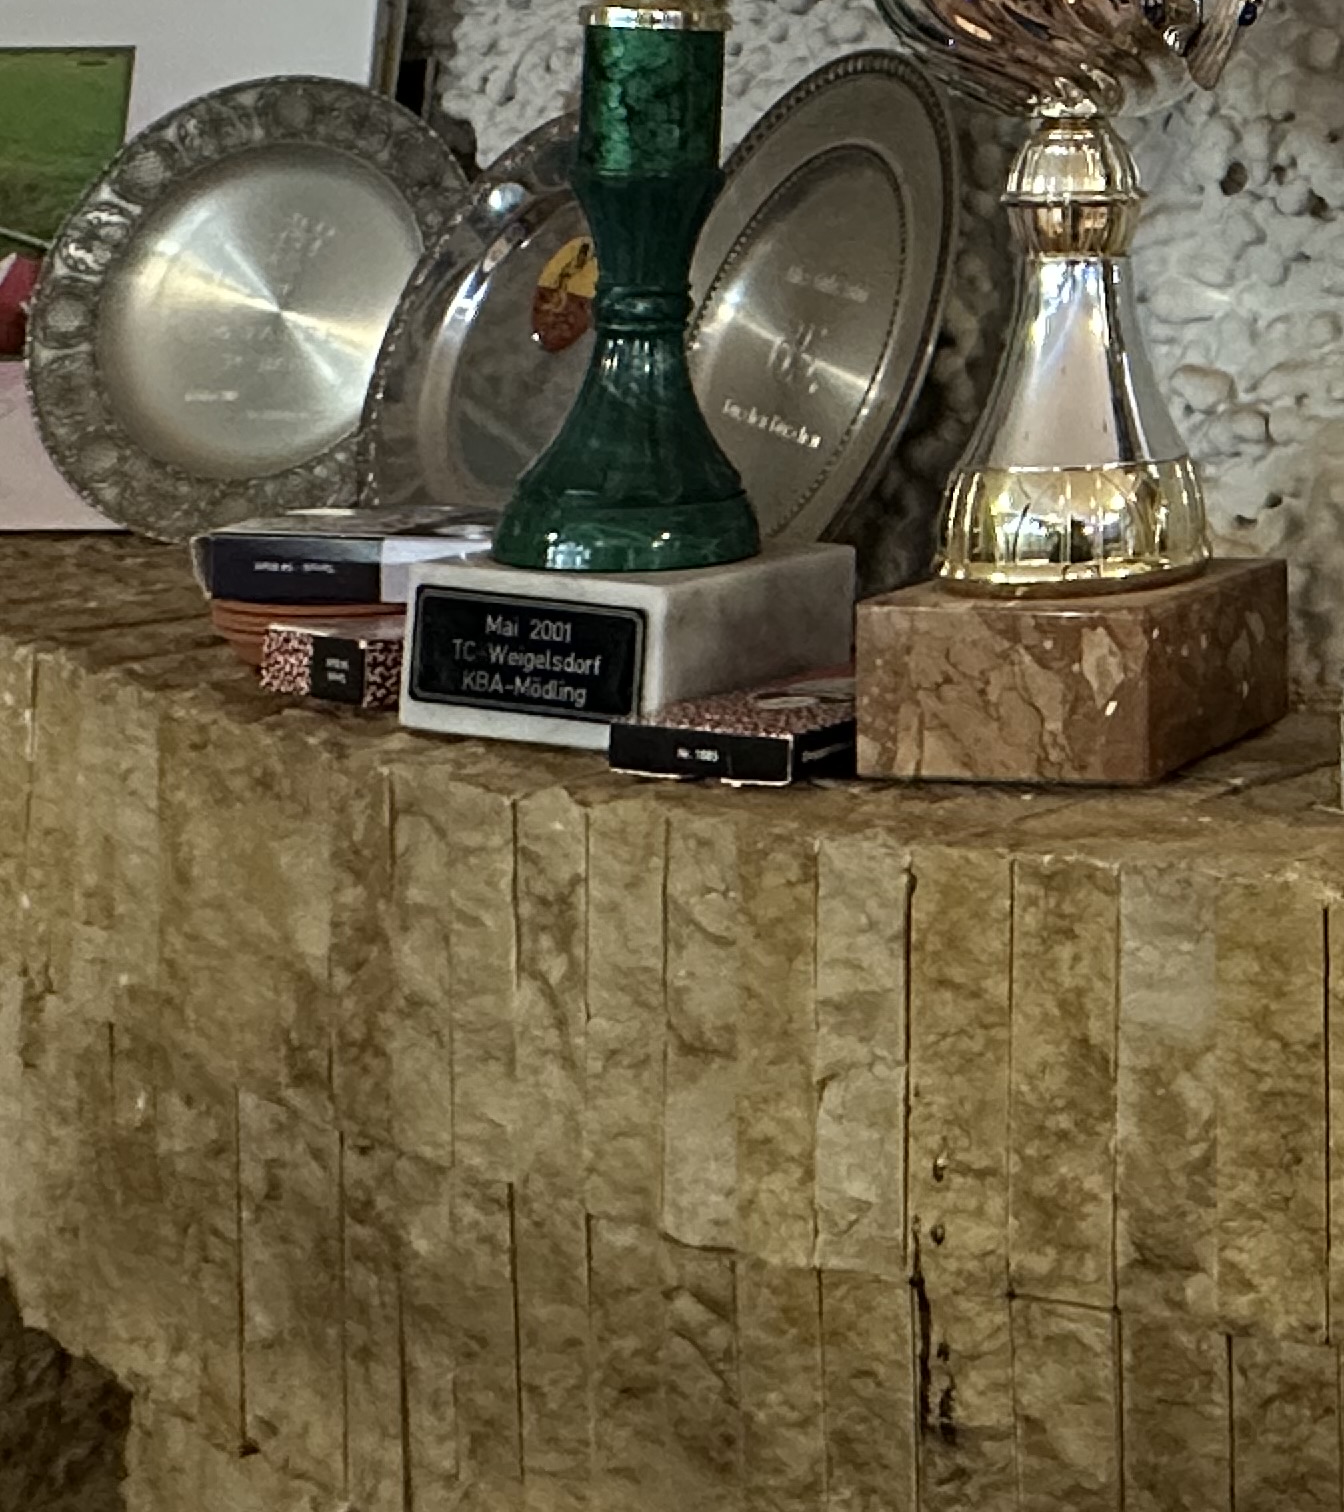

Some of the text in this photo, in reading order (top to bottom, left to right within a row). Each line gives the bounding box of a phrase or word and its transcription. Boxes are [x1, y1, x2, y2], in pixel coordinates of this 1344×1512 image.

[485, 614, 572, 643] Mai 2001
[461, 668, 587, 708] KBA-Mödling
